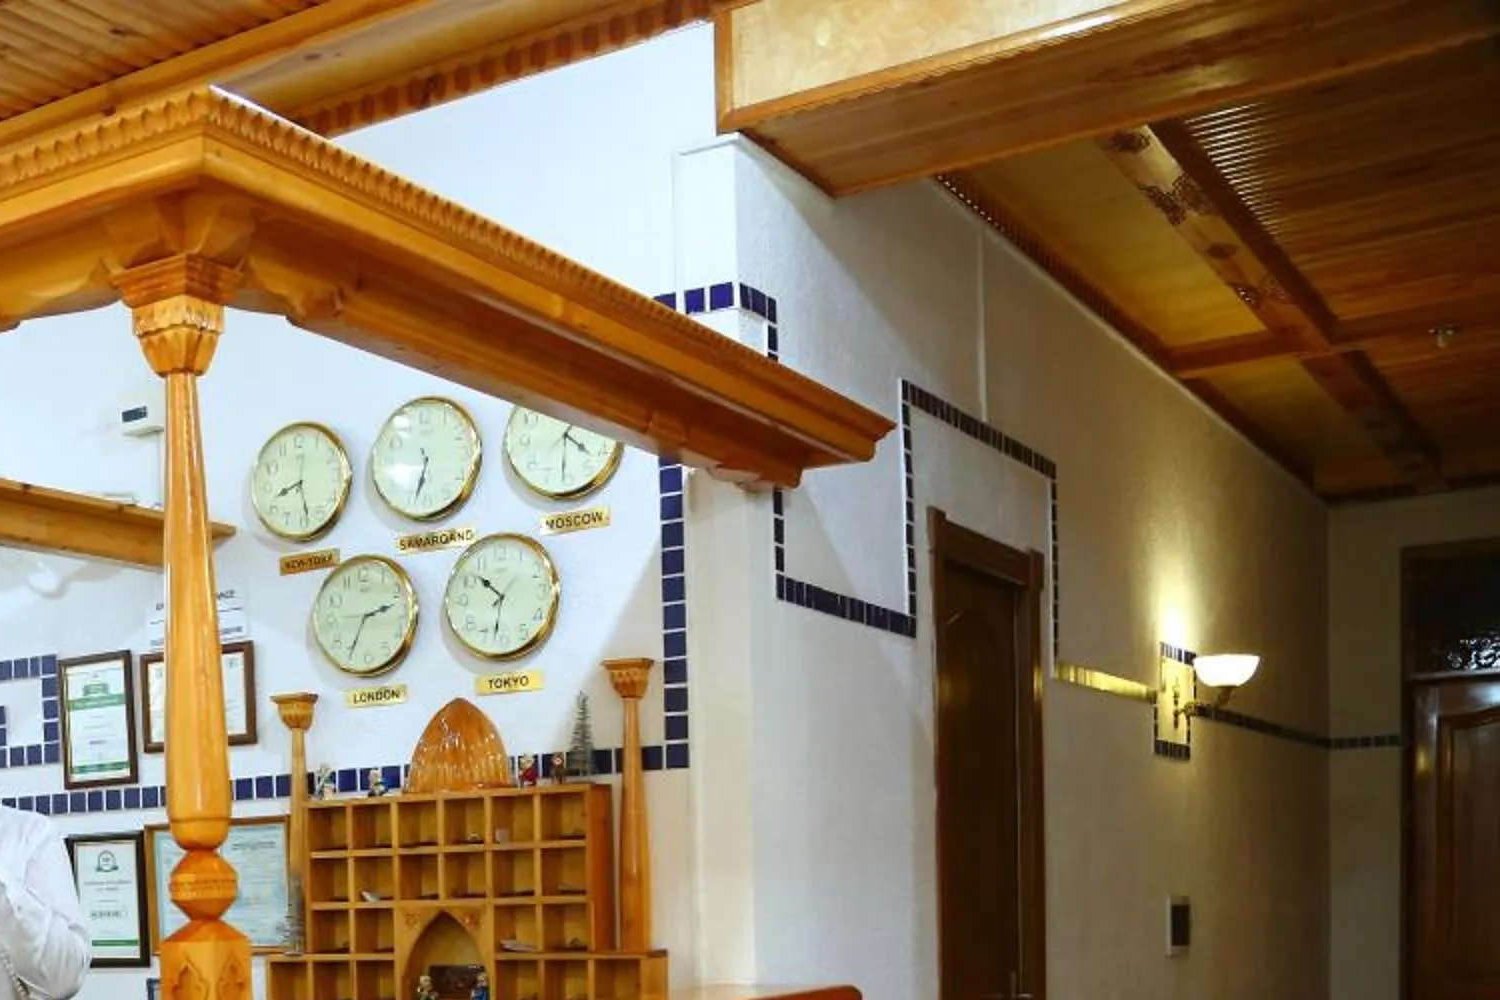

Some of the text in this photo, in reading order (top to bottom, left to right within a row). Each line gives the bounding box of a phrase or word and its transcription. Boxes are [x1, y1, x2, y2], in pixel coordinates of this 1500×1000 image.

[545, 511, 604, 530] MOSCOW
[488, 675, 529, 688] TOKYO
[353, 689, 400, 704] LONDON
